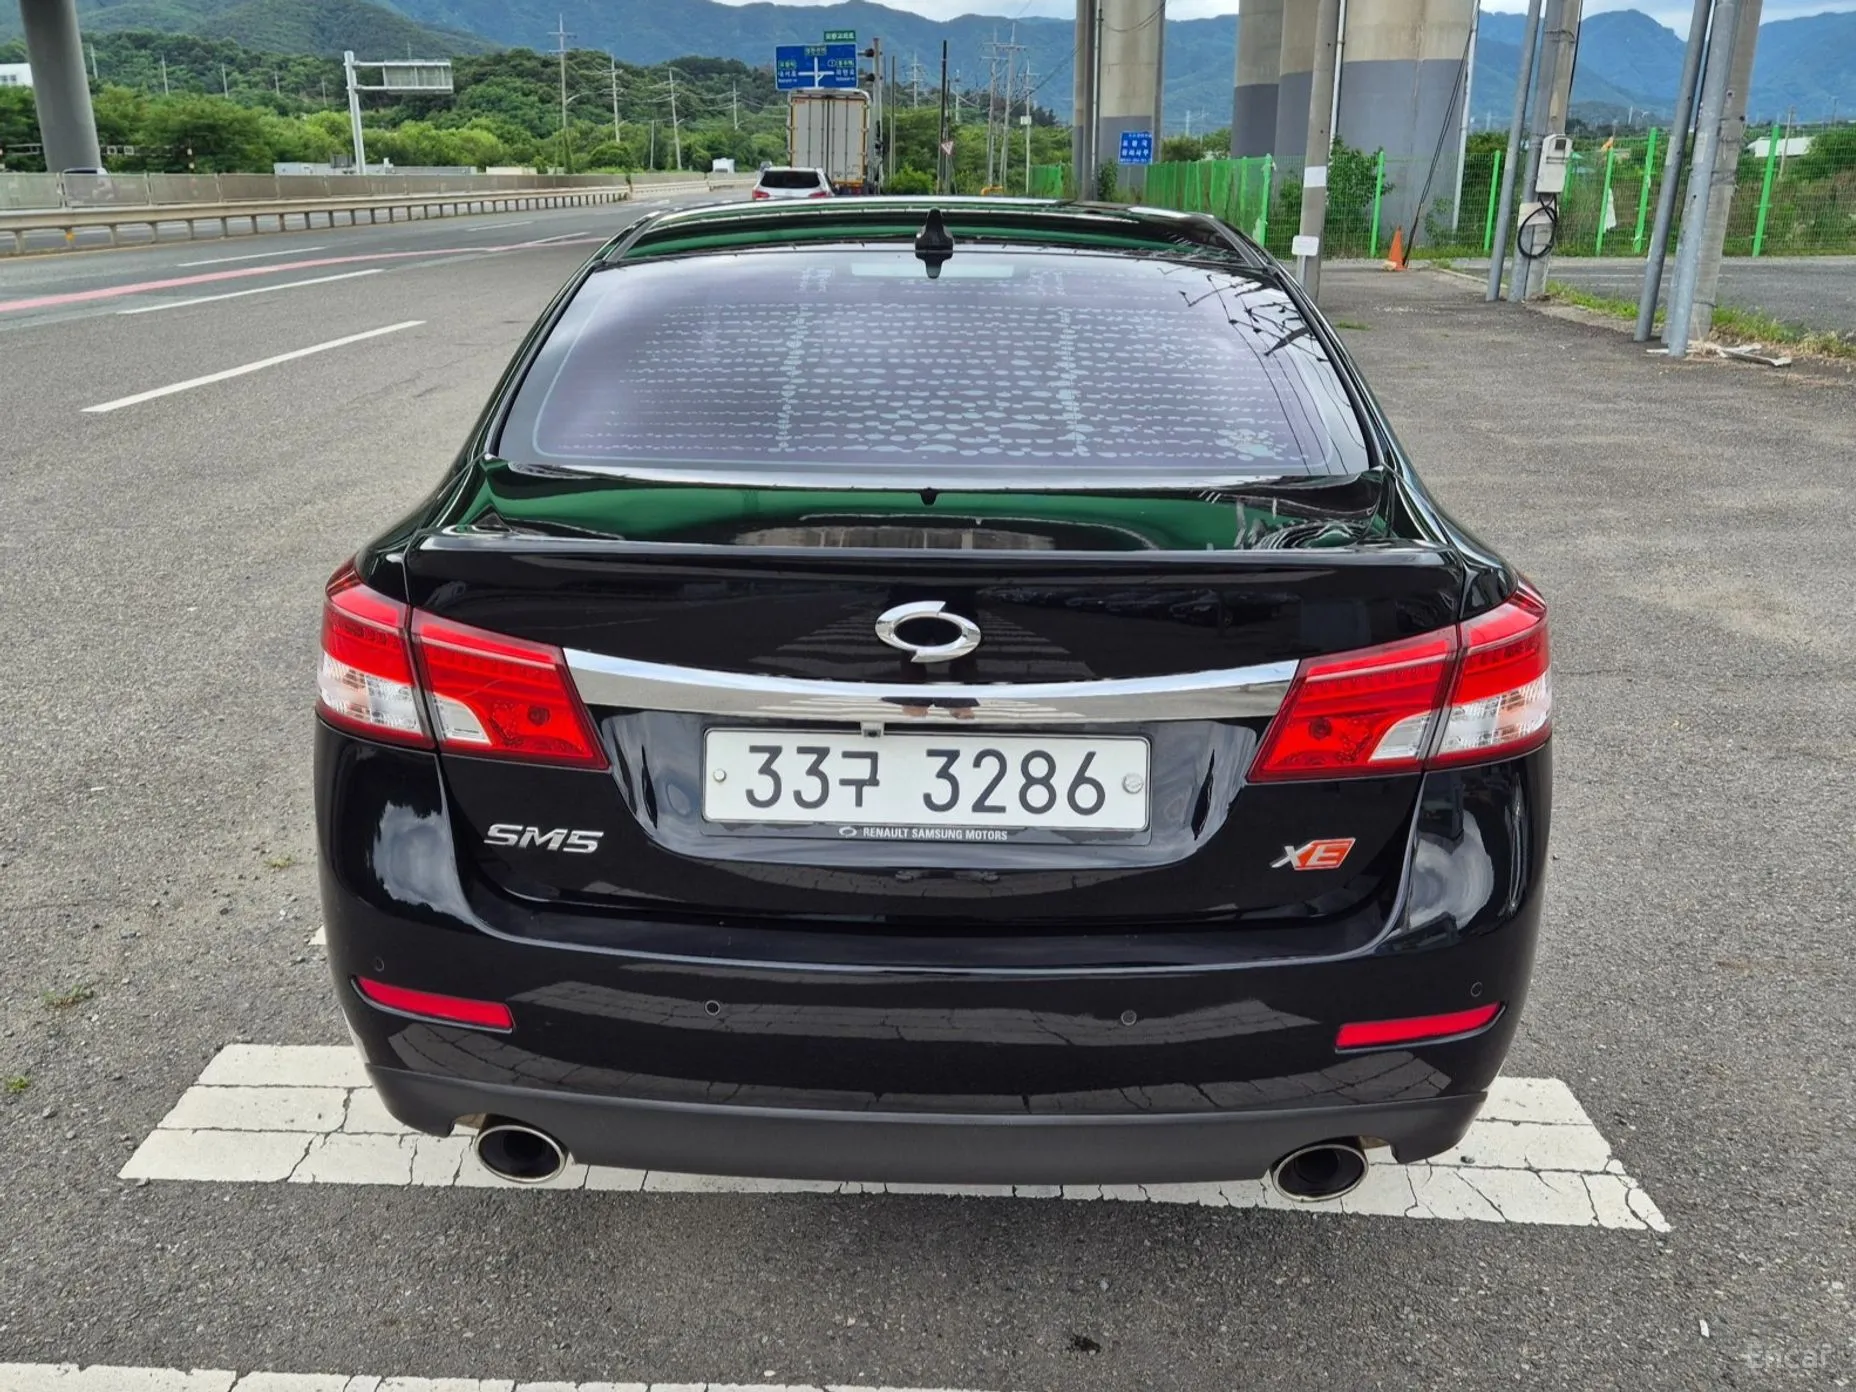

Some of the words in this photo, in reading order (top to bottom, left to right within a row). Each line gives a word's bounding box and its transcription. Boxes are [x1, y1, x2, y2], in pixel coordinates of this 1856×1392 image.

[745, 745, 880, 809] 33구
[922, 748, 1106, 816] 3286
[483, 823, 604, 854] SM5
[863, 826, 910, 839] RENAULT
[911, 828, 963, 840] SAMSUNG
[965, 829, 1008, 841] MOTORS
